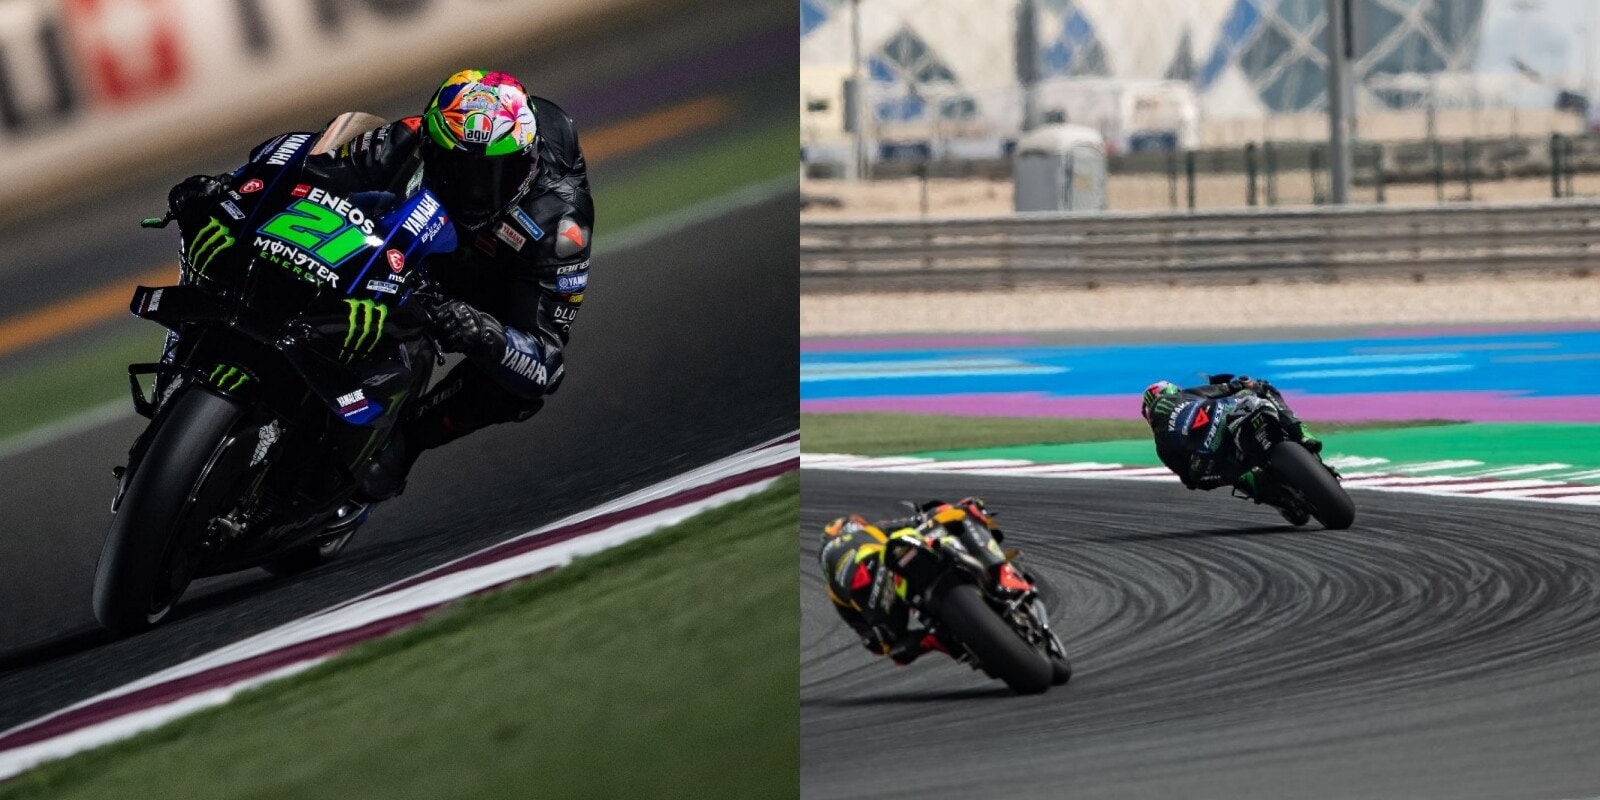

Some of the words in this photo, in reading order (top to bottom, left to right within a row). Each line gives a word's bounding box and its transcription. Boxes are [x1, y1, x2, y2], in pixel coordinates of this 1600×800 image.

[266, 134, 311, 166] YAMAHA
[467, 130, 489, 141] agv
[307, 187, 375, 235] ENEOS
[402, 192, 441, 237] YAMAHA
[256, 198, 376, 269] 21
[502, 225, 525, 246] YAMAHA
[260, 251, 324, 288] ENERGY
[388, 273, 406, 284] msi
[501, 346, 548, 386] YAMAHA
